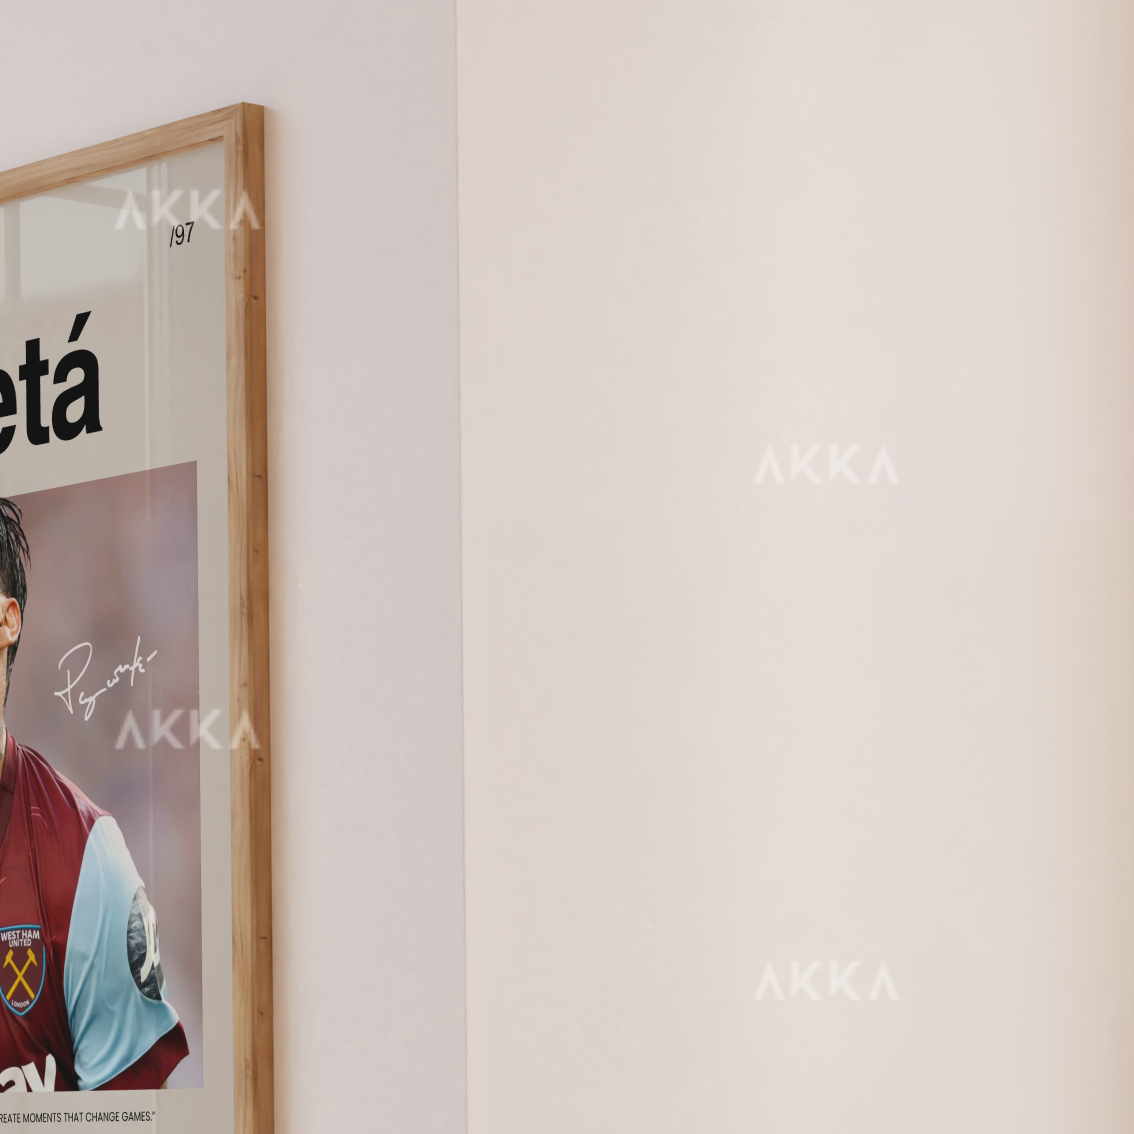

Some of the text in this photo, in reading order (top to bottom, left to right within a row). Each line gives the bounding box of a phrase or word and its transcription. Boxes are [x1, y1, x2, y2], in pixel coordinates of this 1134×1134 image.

[169, 221, 195, 248] /97
[1, 930, 40, 941] WEST HAM
[8, 938, 32, 947] UNITED
[11, 999, 30, 1008] LONDON
[22, 1112, 62, 1123] MOMENTS
[64, 1112, 83, 1122] THAT
[85, 1111, 120, 1122] CHANGE
